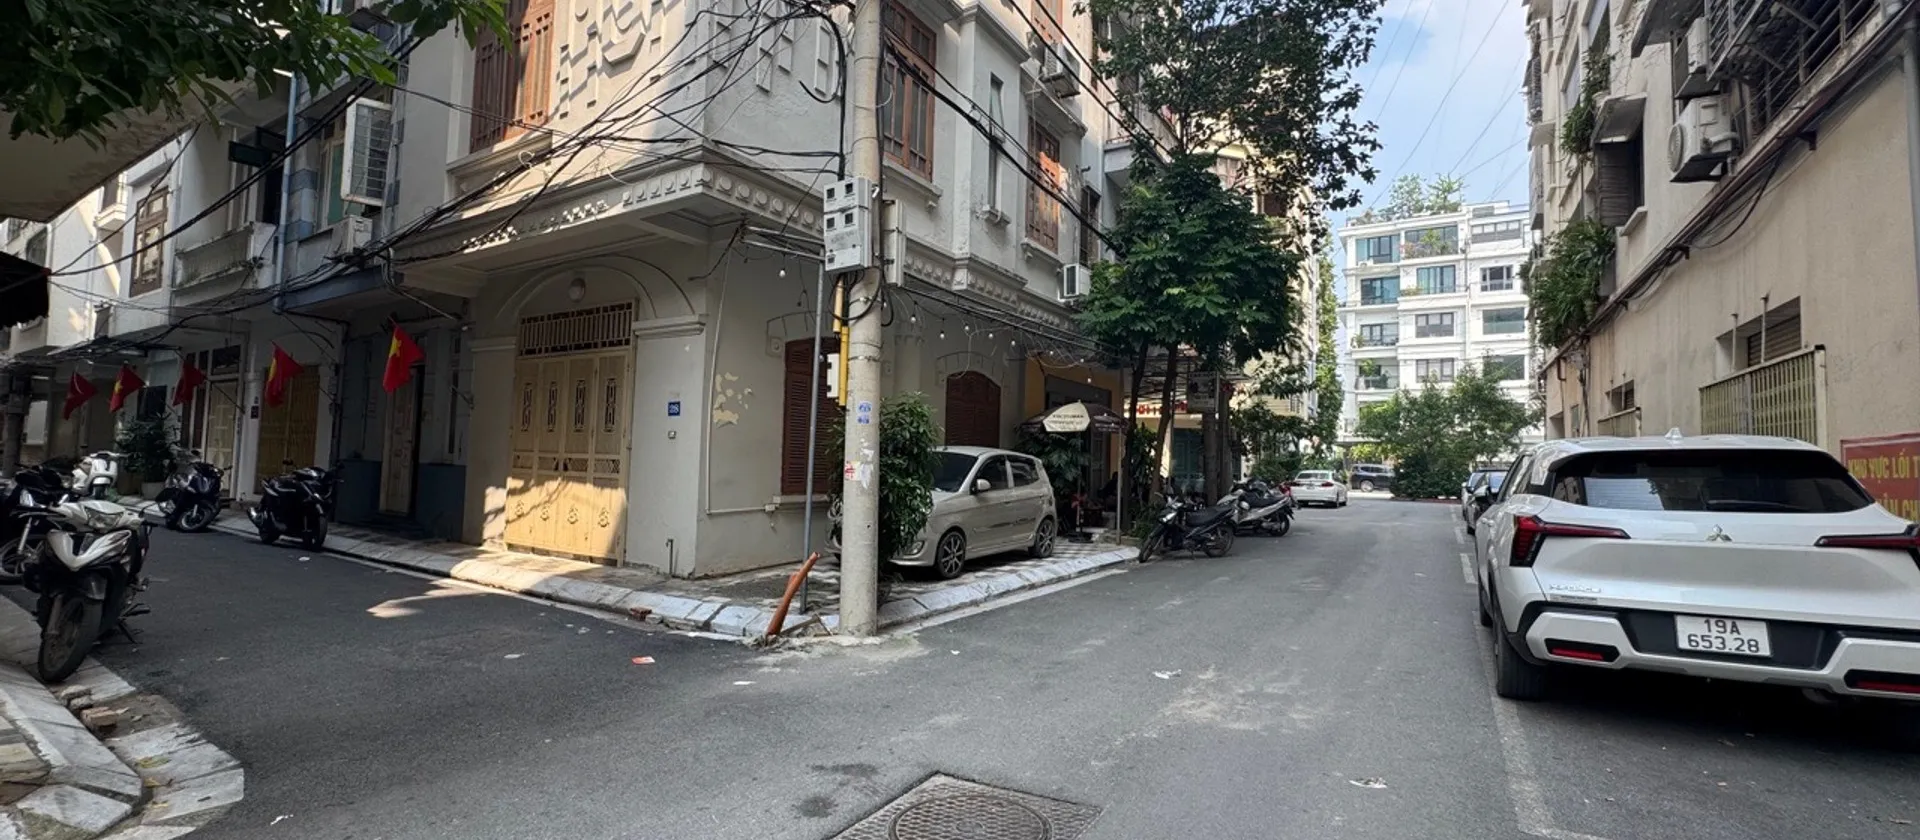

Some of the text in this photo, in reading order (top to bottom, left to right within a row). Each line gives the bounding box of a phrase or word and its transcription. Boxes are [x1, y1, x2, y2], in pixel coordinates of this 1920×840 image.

[1848, 459, 1868, 478] KHU
[1868, 455, 1889, 484] VỰC
[1891, 448, 1910, 478] LỐI
[1704, 618, 1741, 636] 19A
[1687, 633, 1760, 653] 653.28
